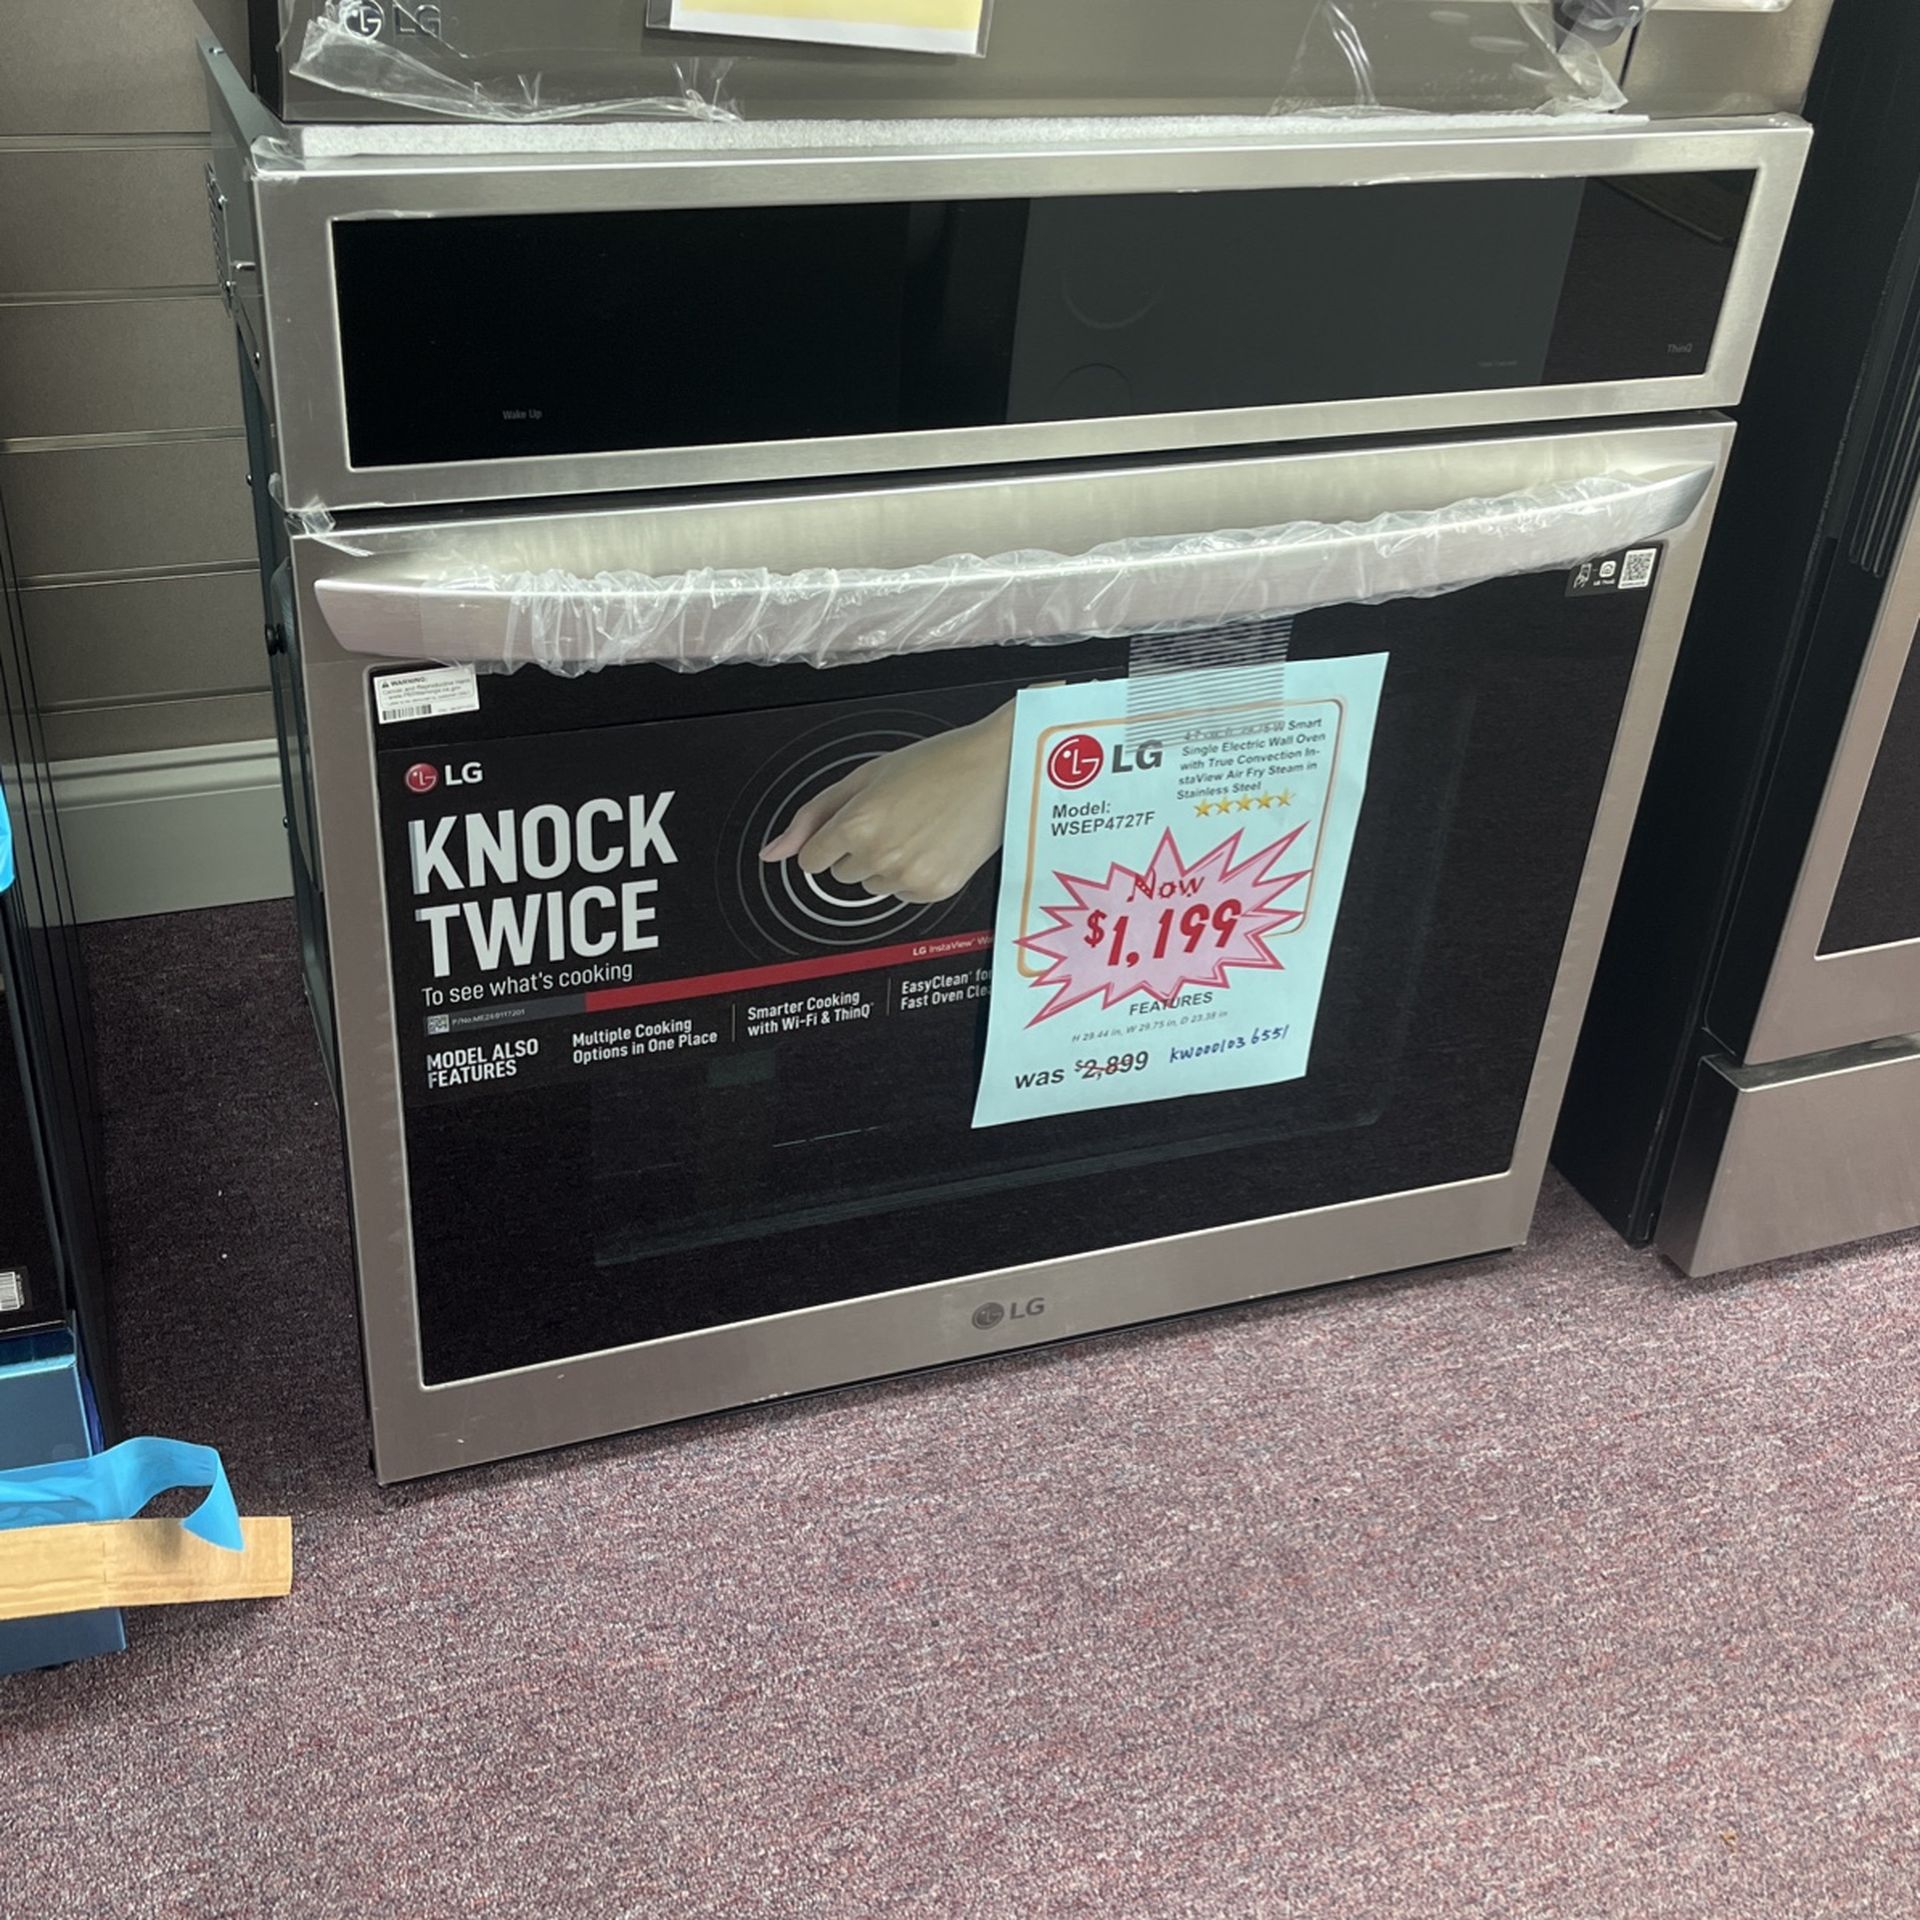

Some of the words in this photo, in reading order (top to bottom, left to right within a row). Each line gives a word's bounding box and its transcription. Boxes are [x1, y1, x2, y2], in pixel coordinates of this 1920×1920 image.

[393, 4, 441, 35] LG
[1667, 342, 1693, 353] ThinQ
[502, 409, 527, 420] Wake
[528, 408, 543, 420] Up
[1288, 718, 1322, 731] Smart
[1111, 739, 1164, 774] LG
[1182, 744, 1219, 757] Single
[1221, 739, 1265, 753] Electric
[1269, 735, 1294, 747] Wall
[1296, 733, 1326, 744] Oven
[1180, 758, 1205, 771] with
[1208, 757, 1234, 768] True
[1237, 750, 1302, 765] Convection
[1304, 747, 1320, 756] In-
[445, 762, 483, 786] LG
[1178, 773, 1223, 785] staView
[1226, 770, 1244, 780] Air
[1246, 767, 1266, 779] Fry
[1268, 764, 1304, 776] Steam
[1306, 762, 1318, 771] in
[1177, 786, 1229, 800] Stainless
[1232, 781, 1262, 793] Steel
[1052, 801, 1111, 819] Model:
[1050, 811, 1156, 837] WSEP4727F
[408, 791, 679, 895] KNOCK
[415, 879, 659, 978] TWICE
[1083, 898, 1242, 968] $1,199
[912, 946, 927, 956] LG
[422, 987, 443, 1007] To
[450, 983, 484, 1003] see
[489, 971, 553, 997] what's
[559, 962, 633, 988] cooking
[747, 1002, 803, 1021] Smarter
[807, 992, 860, 1010] Cooking
[901, 995, 929, 1010] Fast
[932, 990, 963, 1005] Oven
[1129, 992, 1213, 1016] FEATURES
[572, 1026, 632, 1047] Multiple
[635, 1019, 692, 1039] Cooking
[748, 1017, 778, 1037] with
[781, 1011, 818, 1031] Wi-Fi
[821, 1010, 830, 1025] &
[1072, 1035, 1080, 1043] H
[1126, 1024, 1136, 1034] W
[1180, 1016, 1189, 1025] D
[427, 1046, 487, 1072] MODEL
[492, 1038, 539, 1060] ALSO
[573, 1042, 628, 1065] Options
[632, 1041, 645, 1055] in
[648, 1037, 674, 1052] One
[679, 1031, 718, 1048] Place
[428, 1059, 518, 1089] FEATURES
[1015, 1067, 1064, 1090] was
[1074, 1050, 1149, 1080] $2,899
[1010, 1297, 1045, 1320] LG
